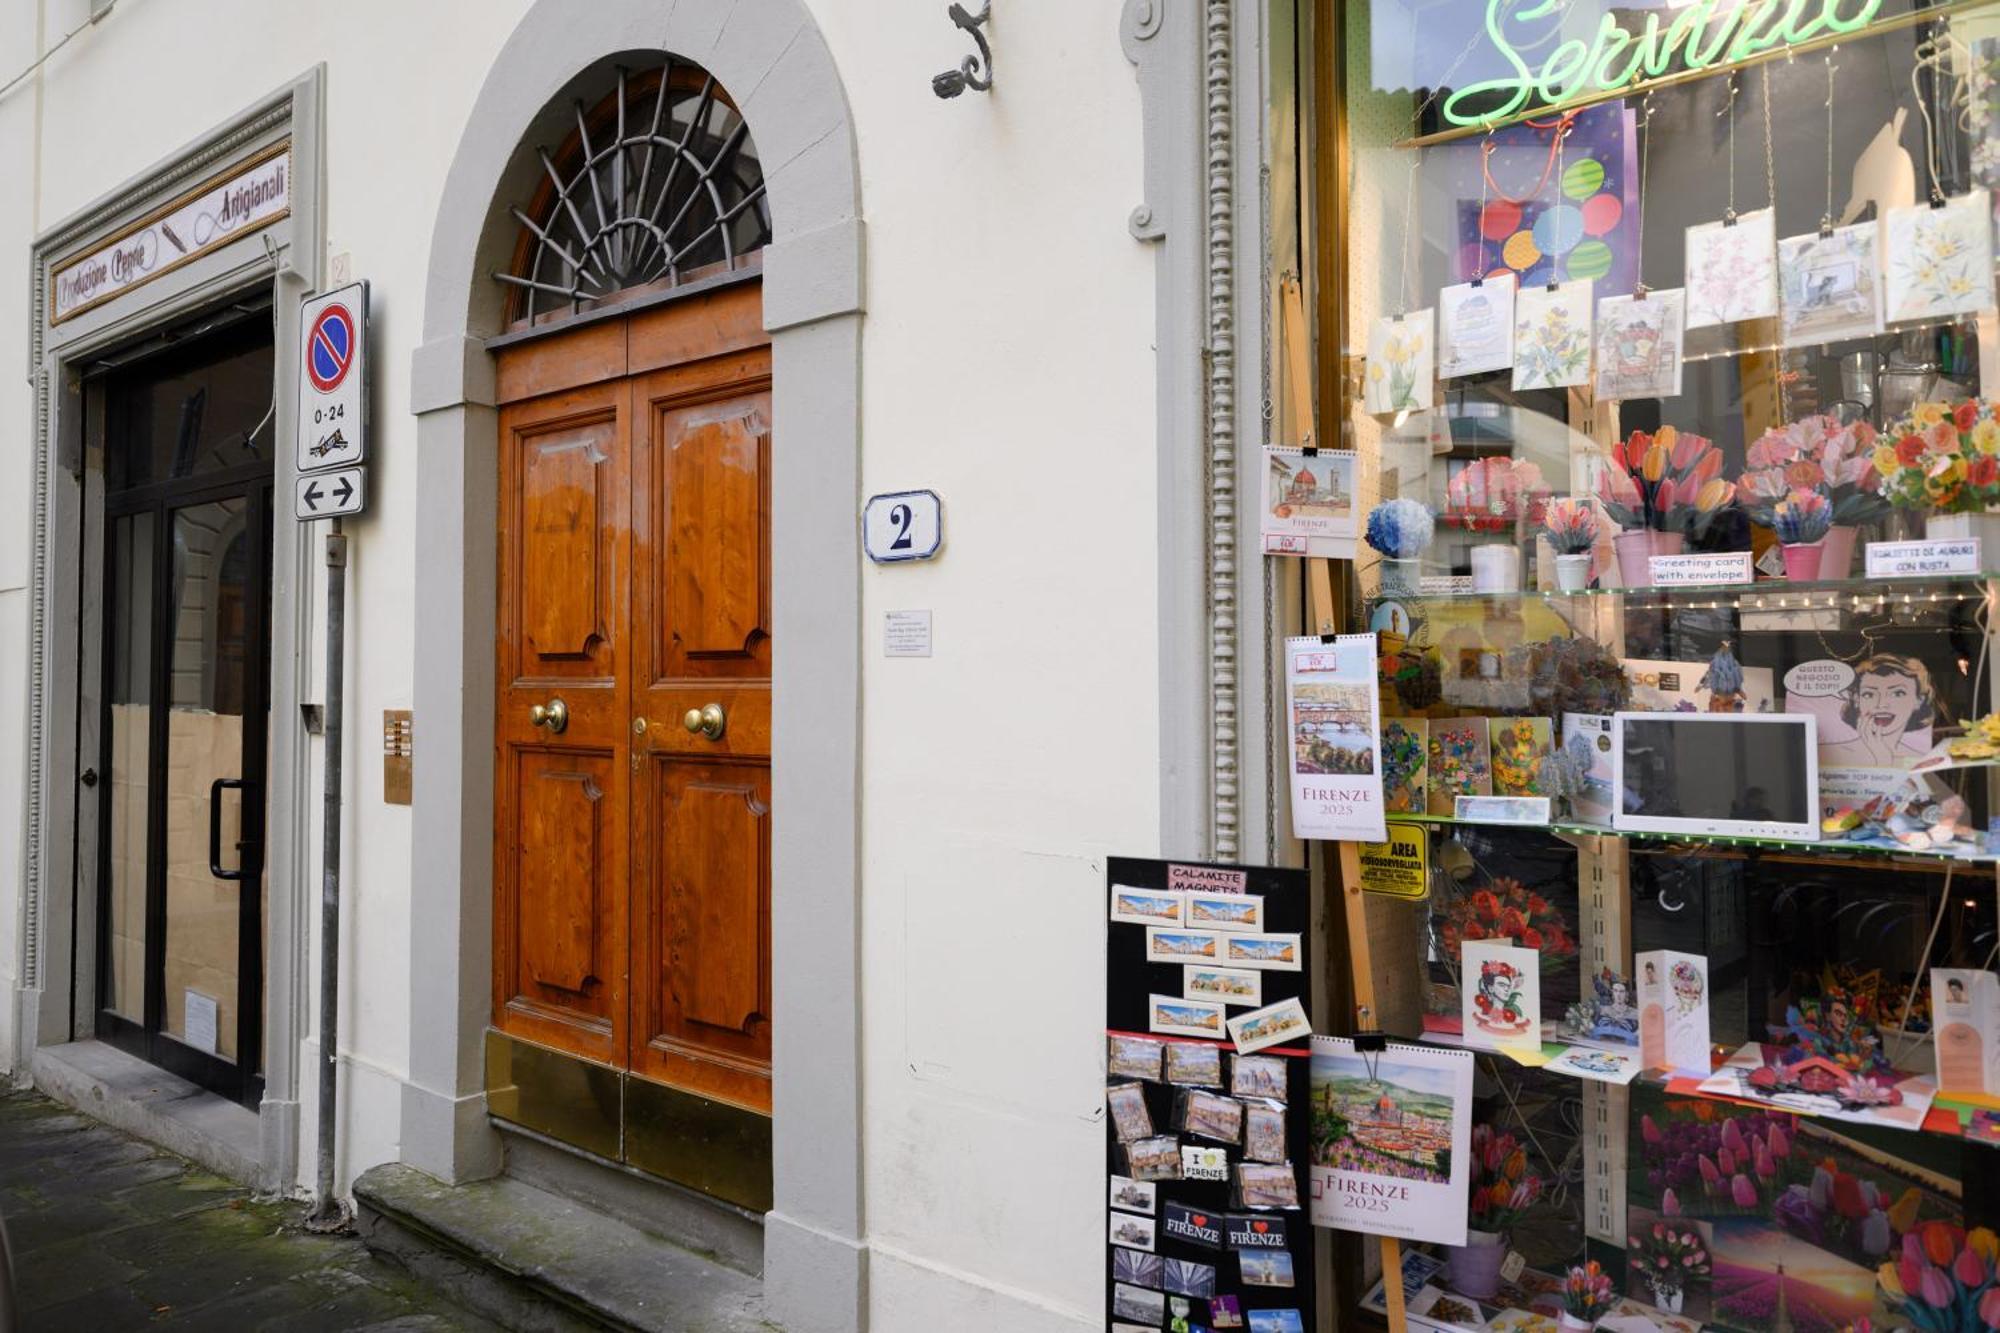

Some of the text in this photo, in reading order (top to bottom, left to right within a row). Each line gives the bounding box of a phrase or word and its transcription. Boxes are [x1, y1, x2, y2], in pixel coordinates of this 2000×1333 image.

[60, 166, 284, 305] Produzione Penne Artigianali
[890, 504, 912, 550] 2
[1292, 519, 1327, 528] FIRENZE
[1923, 547, 1935, 557] DI
[1938, 545, 1974, 556] AUGURI
[1655, 557, 1745, 569] Greeting card
[1896, 561, 1950, 572] CON BUSTA
[1656, 570, 1743, 580] with envelope
[1302, 787, 1372, 802] FIRENZE
[1320, 803, 1353, 816] 2025
[1391, 841, 1418, 858] AREA
[1173, 868, 1241, 884] CALAMITE
[1174, 881, 1239, 895] MAGNETS
[1193, 1153, 1200, 1165] I
[1186, 1167, 1225, 1179] FIRENZE
[1327, 1174, 1409, 1201] FIRENZE
[1343, 1195, 1390, 1213] 2025
[1184, 1211, 1191, 1225] I
[1166, 1218, 1220, 1244] FIRENZE
[1245, 1220, 1252, 1234] I
[1230, 1231, 1285, 1247] FIRENZE
